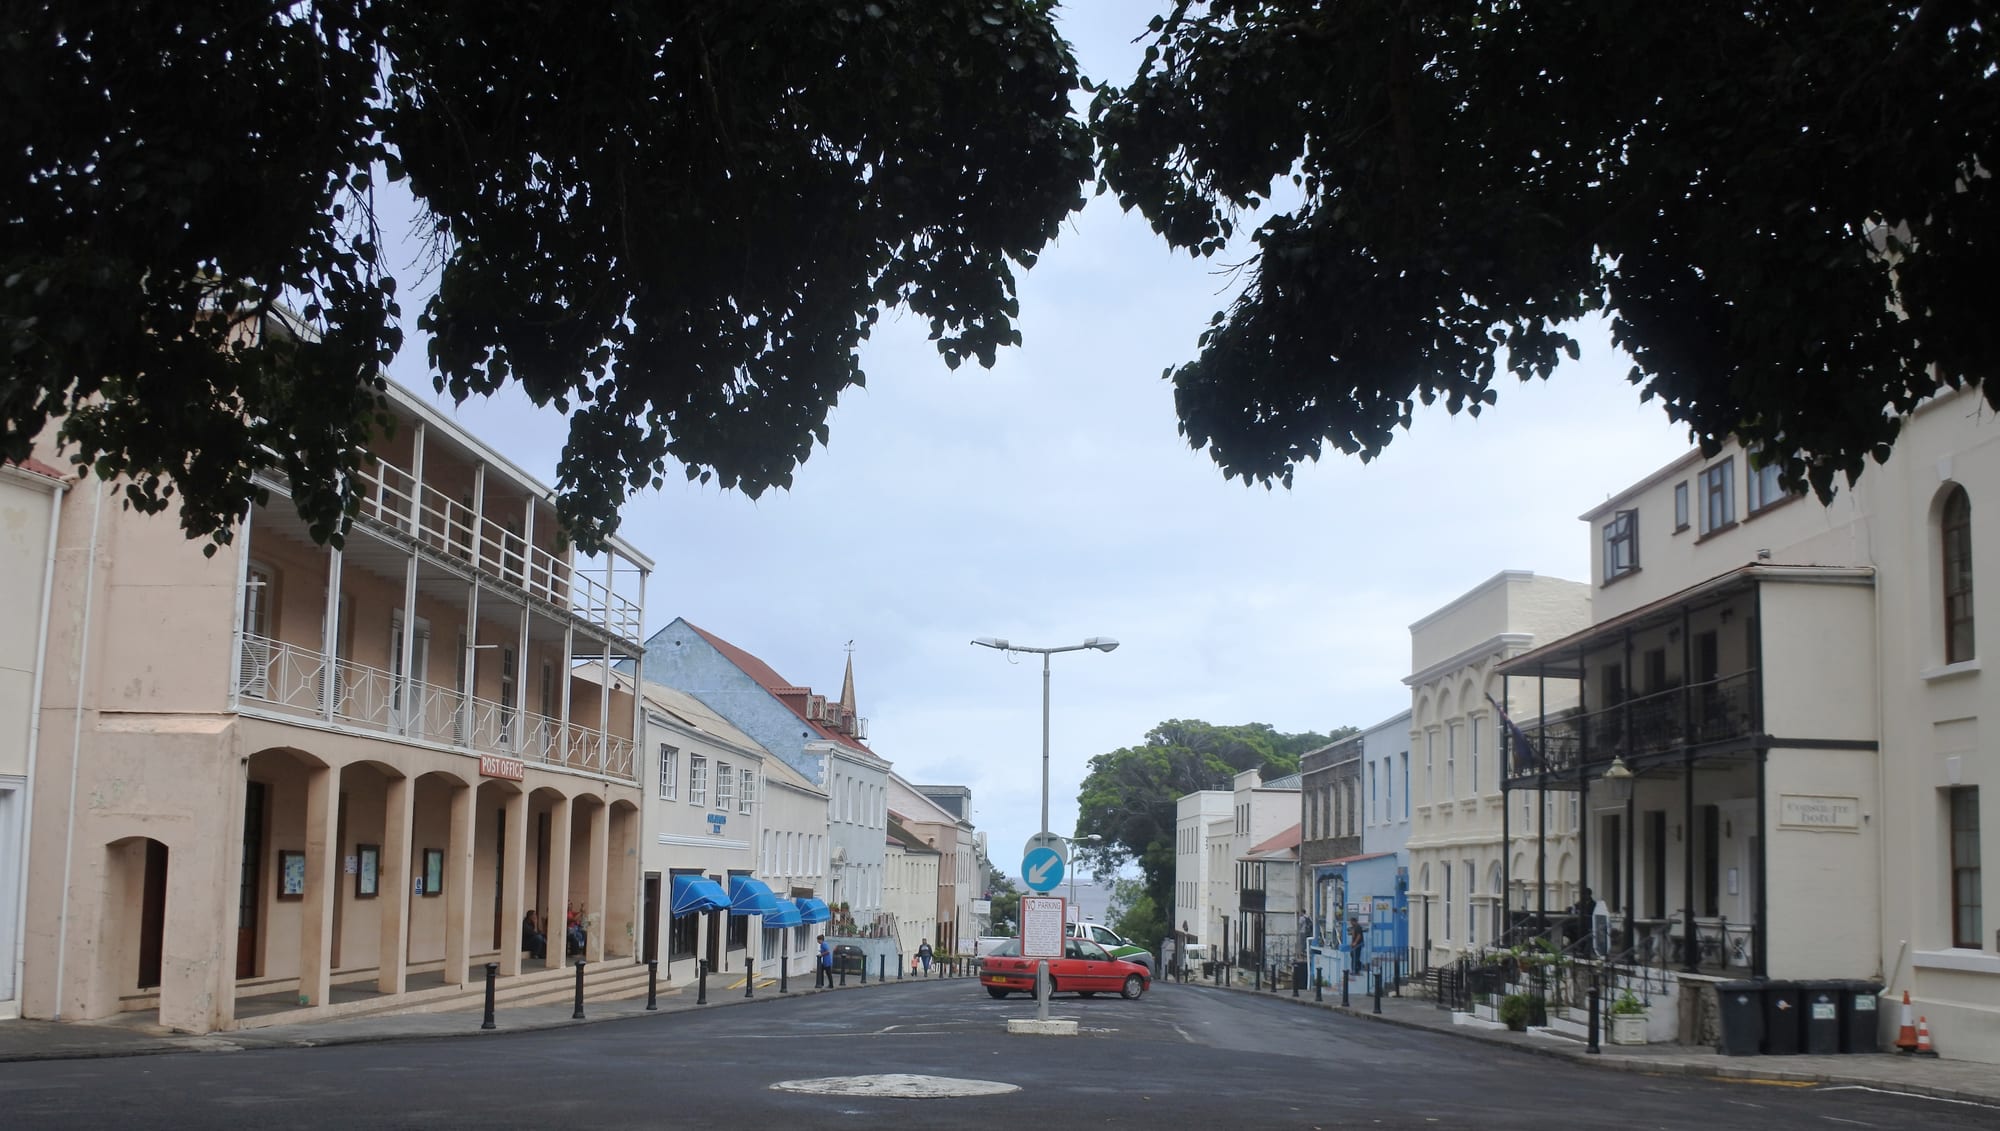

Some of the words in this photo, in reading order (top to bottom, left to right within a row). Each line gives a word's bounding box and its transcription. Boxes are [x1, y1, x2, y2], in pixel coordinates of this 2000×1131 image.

[482, 756, 500, 774] POST
[501, 760, 524, 778] OFFICE
[1025, 900, 1036, 911] NO
[1038, 901, 1061, 910] PARKING
